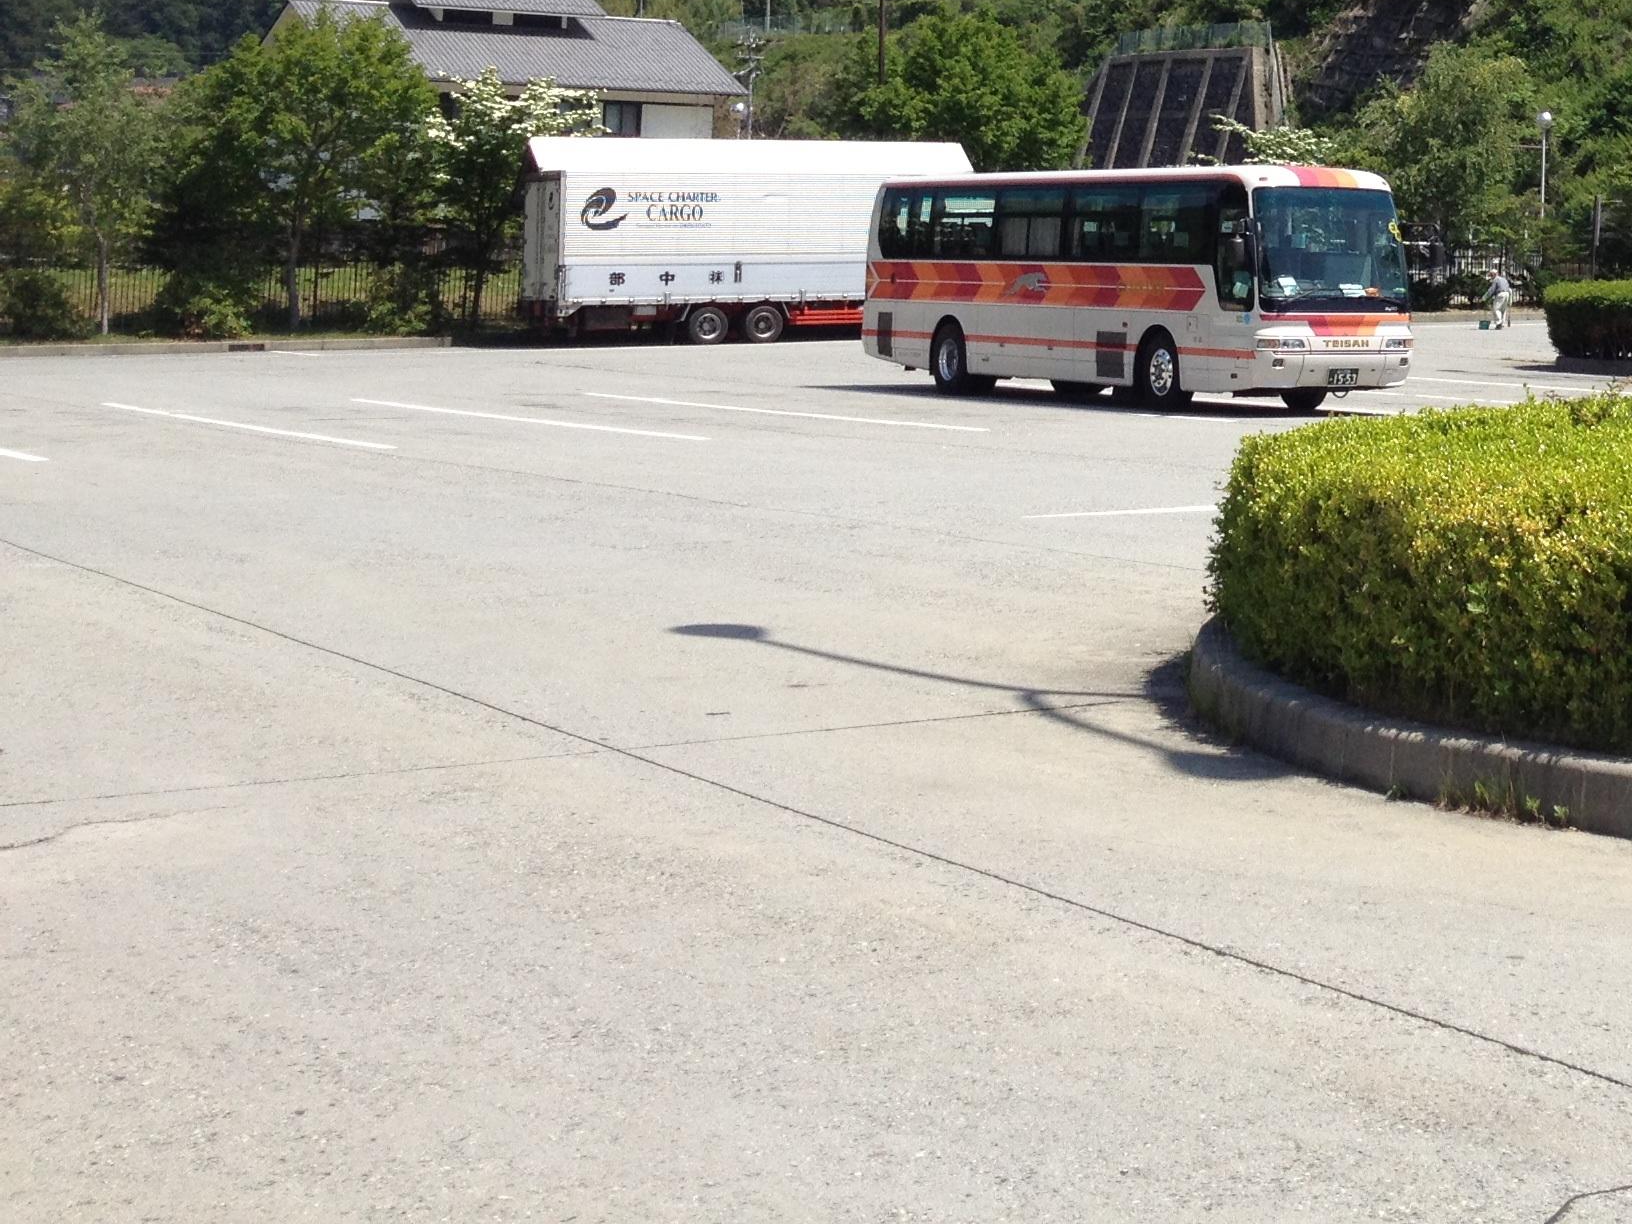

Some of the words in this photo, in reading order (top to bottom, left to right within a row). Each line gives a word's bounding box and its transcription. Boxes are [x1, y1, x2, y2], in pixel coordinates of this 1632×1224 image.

[628, 191, 664, 203] SPACE
[668, 191, 720, 203] CHARTER
[646, 203, 704, 222] CARGO
